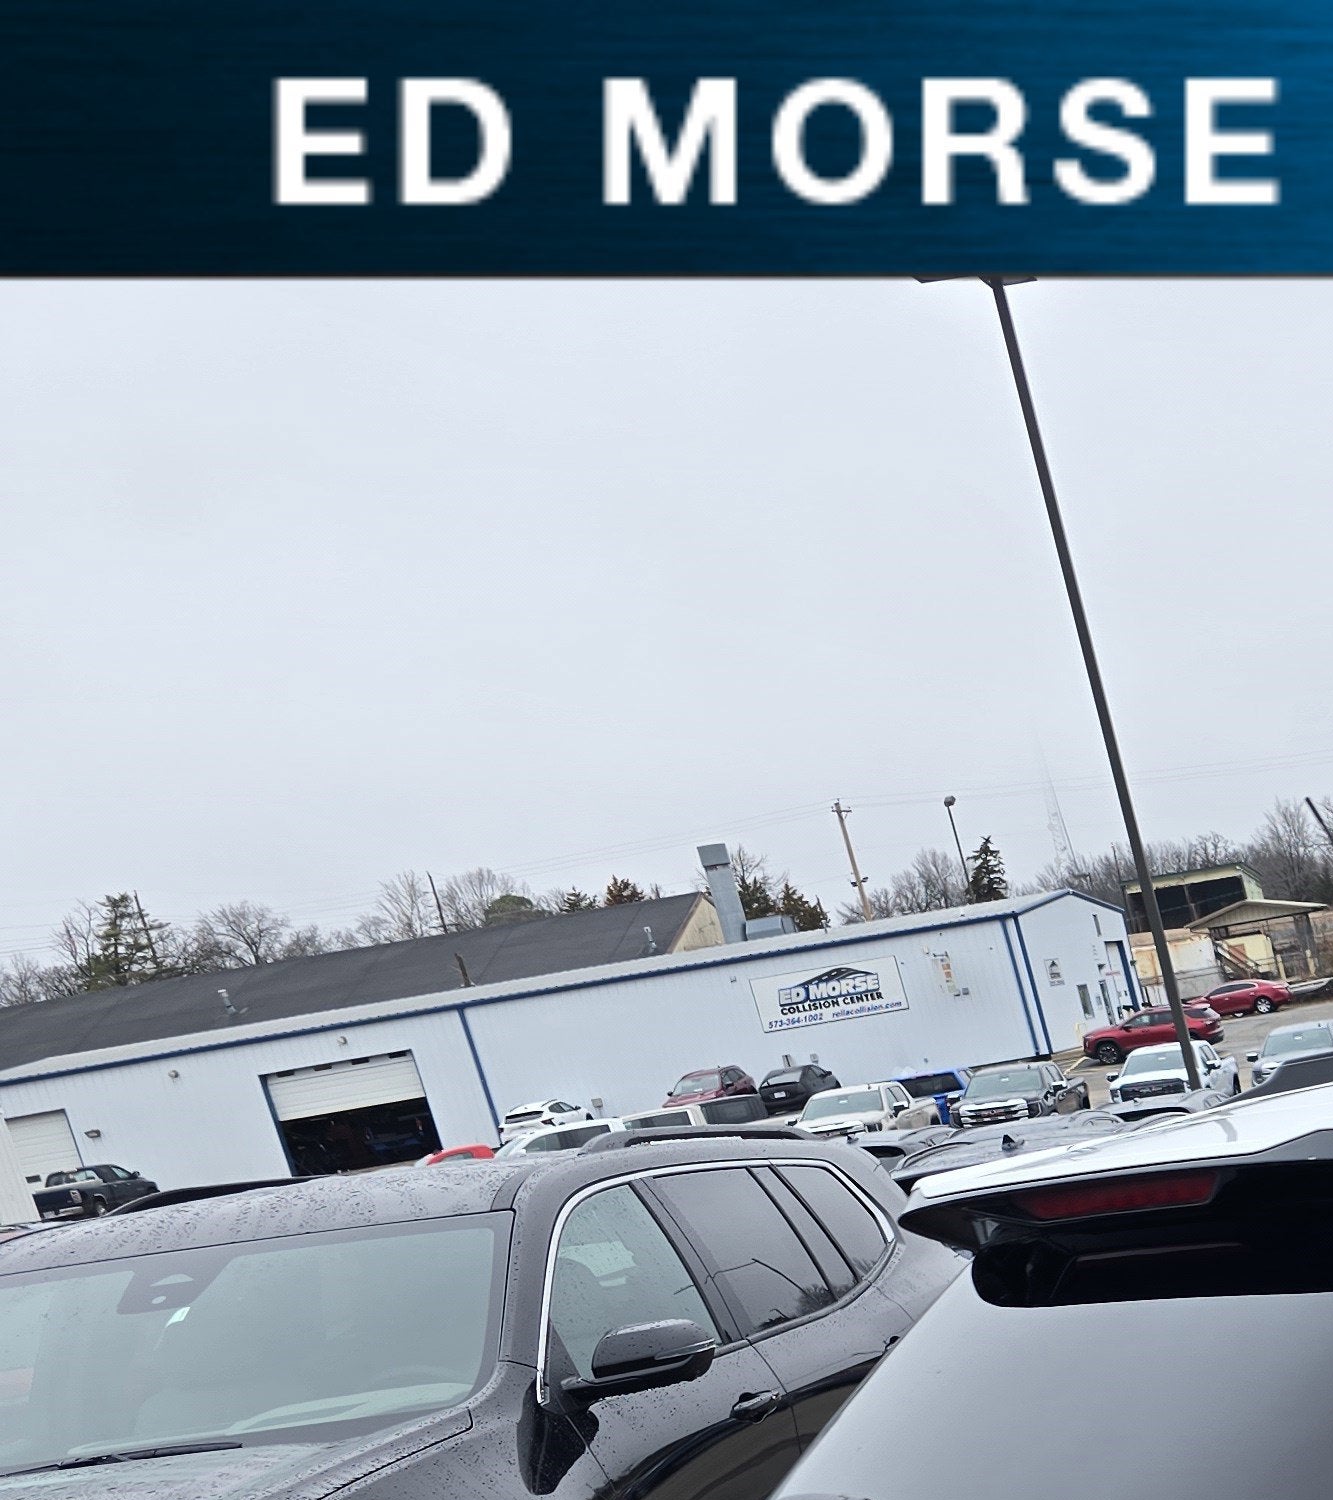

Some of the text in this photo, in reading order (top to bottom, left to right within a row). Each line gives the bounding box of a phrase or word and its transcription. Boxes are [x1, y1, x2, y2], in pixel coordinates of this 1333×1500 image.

[779, 974, 880, 1006] ED MORSE
[781, 991, 884, 1015] COLLISION CENTER
[768, 1013, 824, 1029] 573-364-1002
